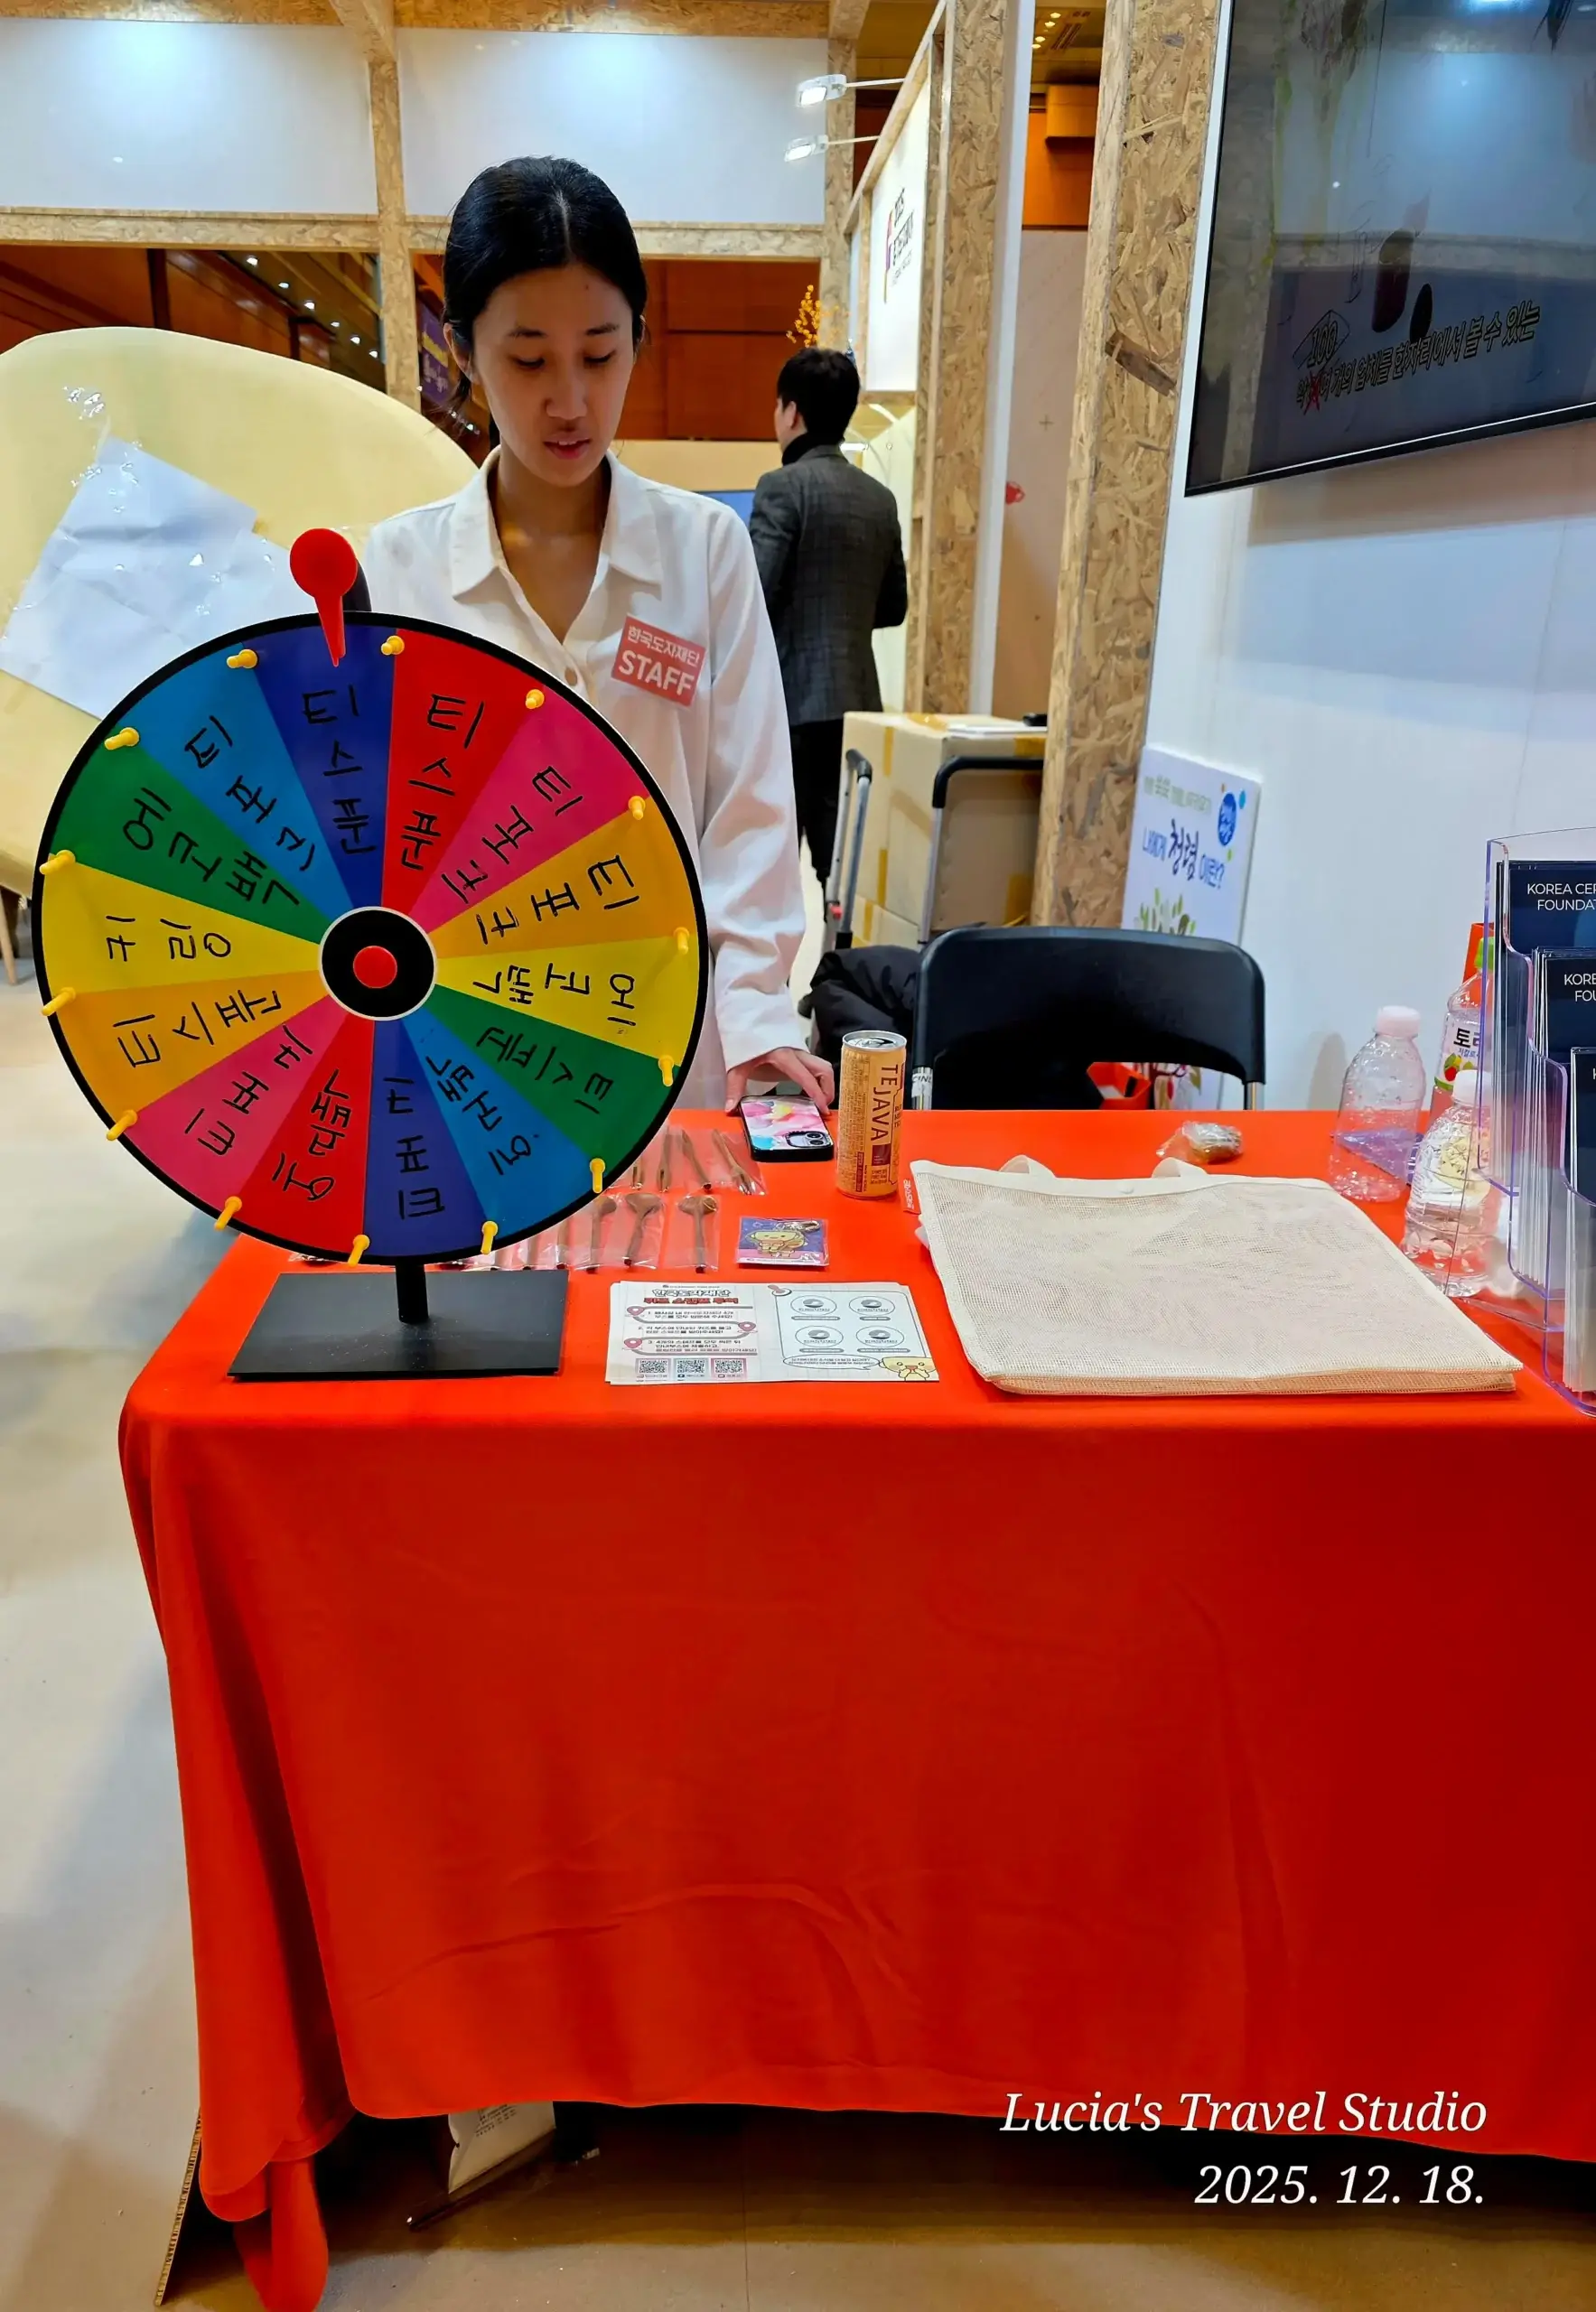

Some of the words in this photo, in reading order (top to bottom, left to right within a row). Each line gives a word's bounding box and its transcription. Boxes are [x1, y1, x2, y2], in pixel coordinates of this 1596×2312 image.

[1356, 349, 1393, 389] 업체를
[1393, 324, 1465, 378] 한자리에서
[1465, 317, 1484, 358] 볼
[1483, 312, 1503, 352] 수
[1503, 300, 1539, 344] 있는
[618, 649, 695, 696] STAFF
[627, 625, 701, 668] 한국도자재단
[301, 684, 378, 855] 티스푼
[400, 693, 485, 871] 티스푼
[122, 787, 300, 906] 에코백
[441, 765, 583, 904] 티포크
[476, 854, 640, 946] 티포크
[1526, 883, 1573, 895] KOREA
[105, 915, 232, 962] 키링
[112, 989, 282, 1068] 티스푼
[472, 962, 637, 1027] 에코백
[475, 1026, 615, 1114] 티스푼
[870, 1064, 899, 1142] TEJAVA
[271, 1068, 351, 1201] 에코백
[382, 1077, 445, 1220] 티포크
[425, 1055, 532, 1176] 에코백
[652, 1289, 731, 1297] 한국도자재단
